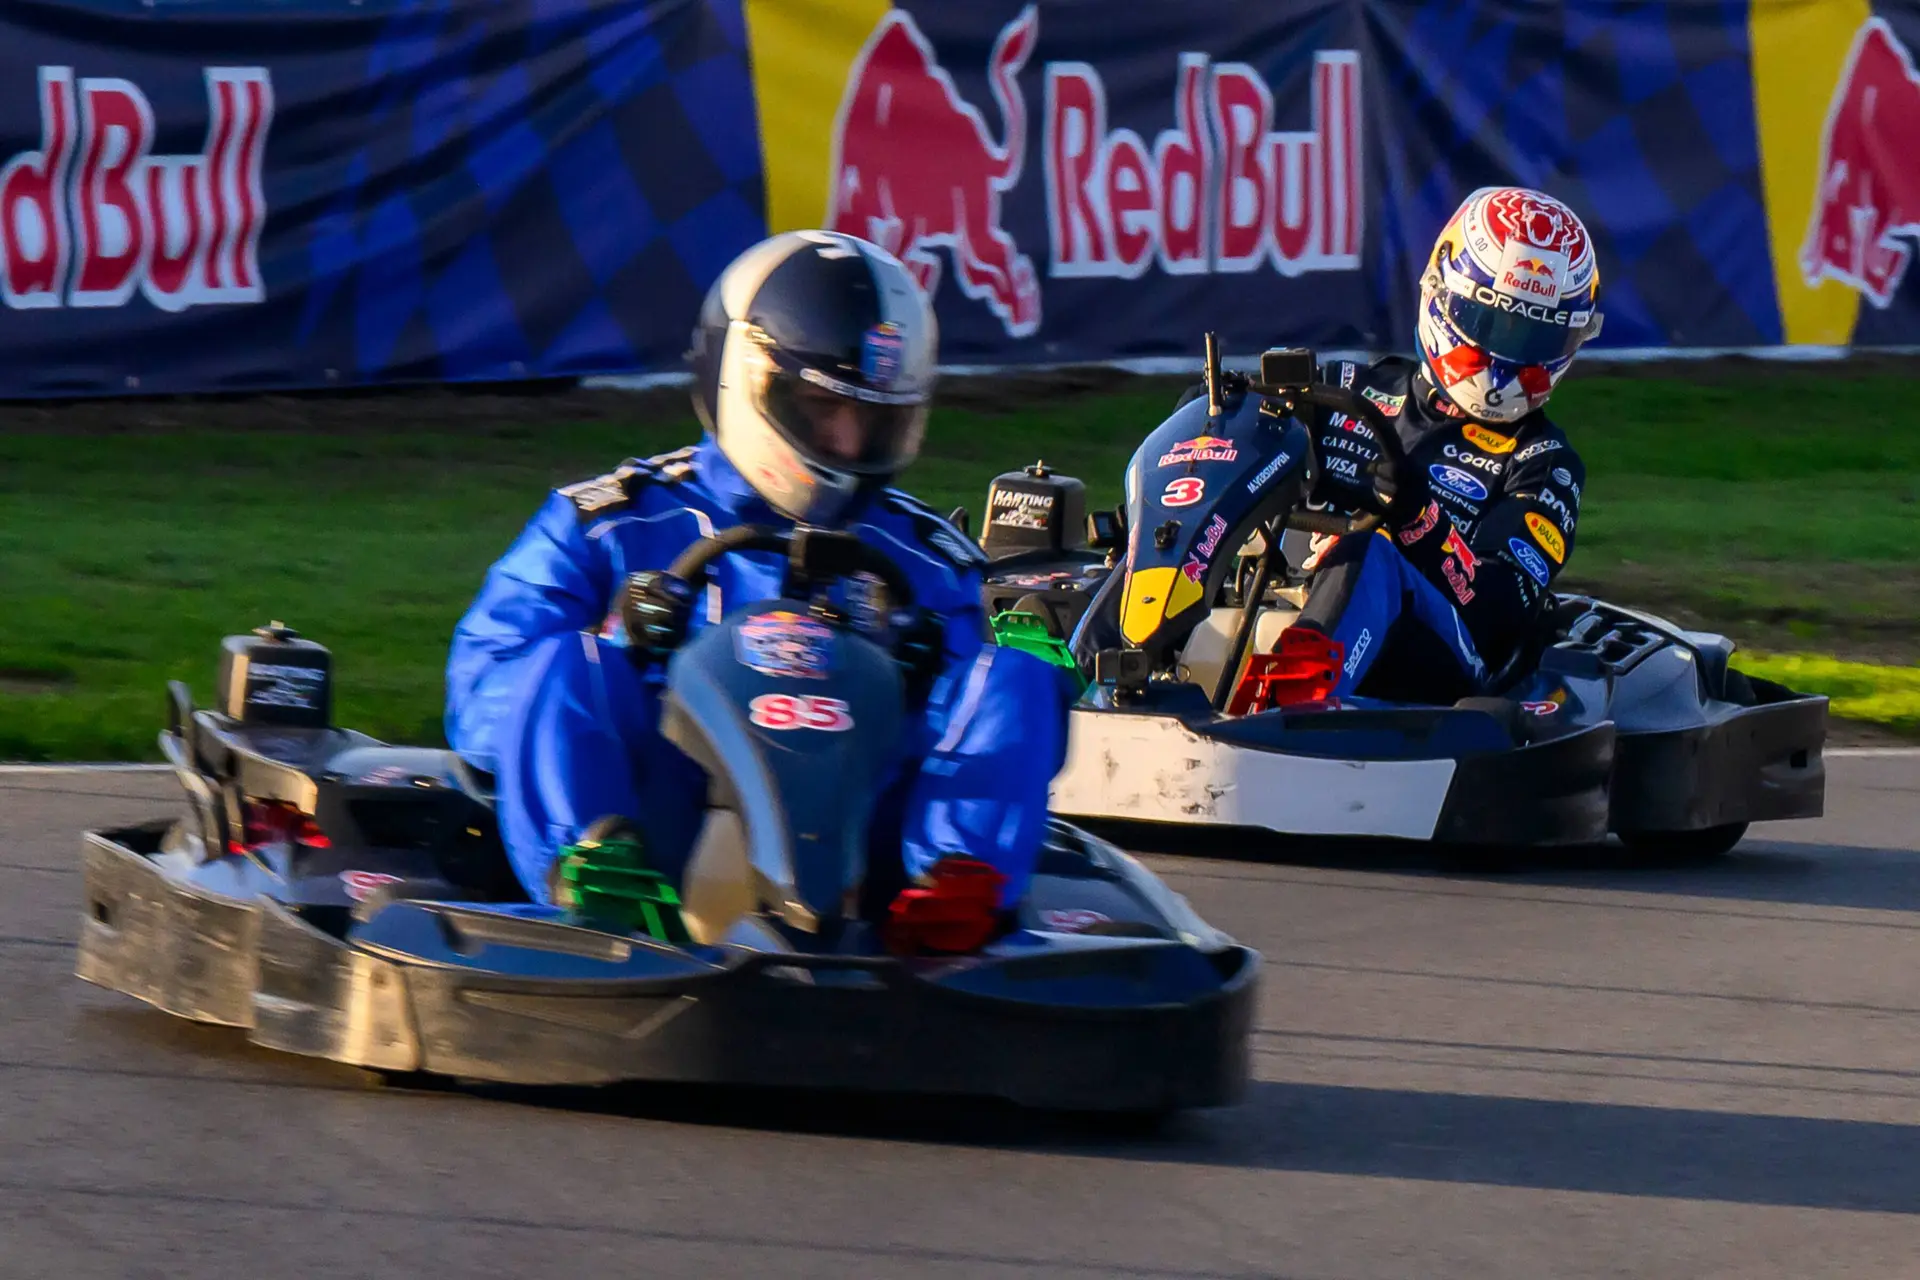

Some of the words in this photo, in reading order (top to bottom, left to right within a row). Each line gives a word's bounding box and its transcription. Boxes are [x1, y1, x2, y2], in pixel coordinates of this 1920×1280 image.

[1043, 51, 1211, 279] Red
[1211, 49, 1363, 278] Bull
[66, 66, 275, 312] Bull
[1503, 271, 1531, 291] Red
[1530, 278, 1557, 297] Bull
[1475, 286, 1568, 325] ORACLE
[1158, 449, 1198, 467] Red
[1196, 448, 1238, 461] Bull
[1325, 456, 1358, 477] VISA
[1160, 476, 1205, 507] 3
[1438, 469, 1478, 494] Ford
[993, 489, 1054, 508] KARTING
[1516, 547, 1546, 578] Ford
